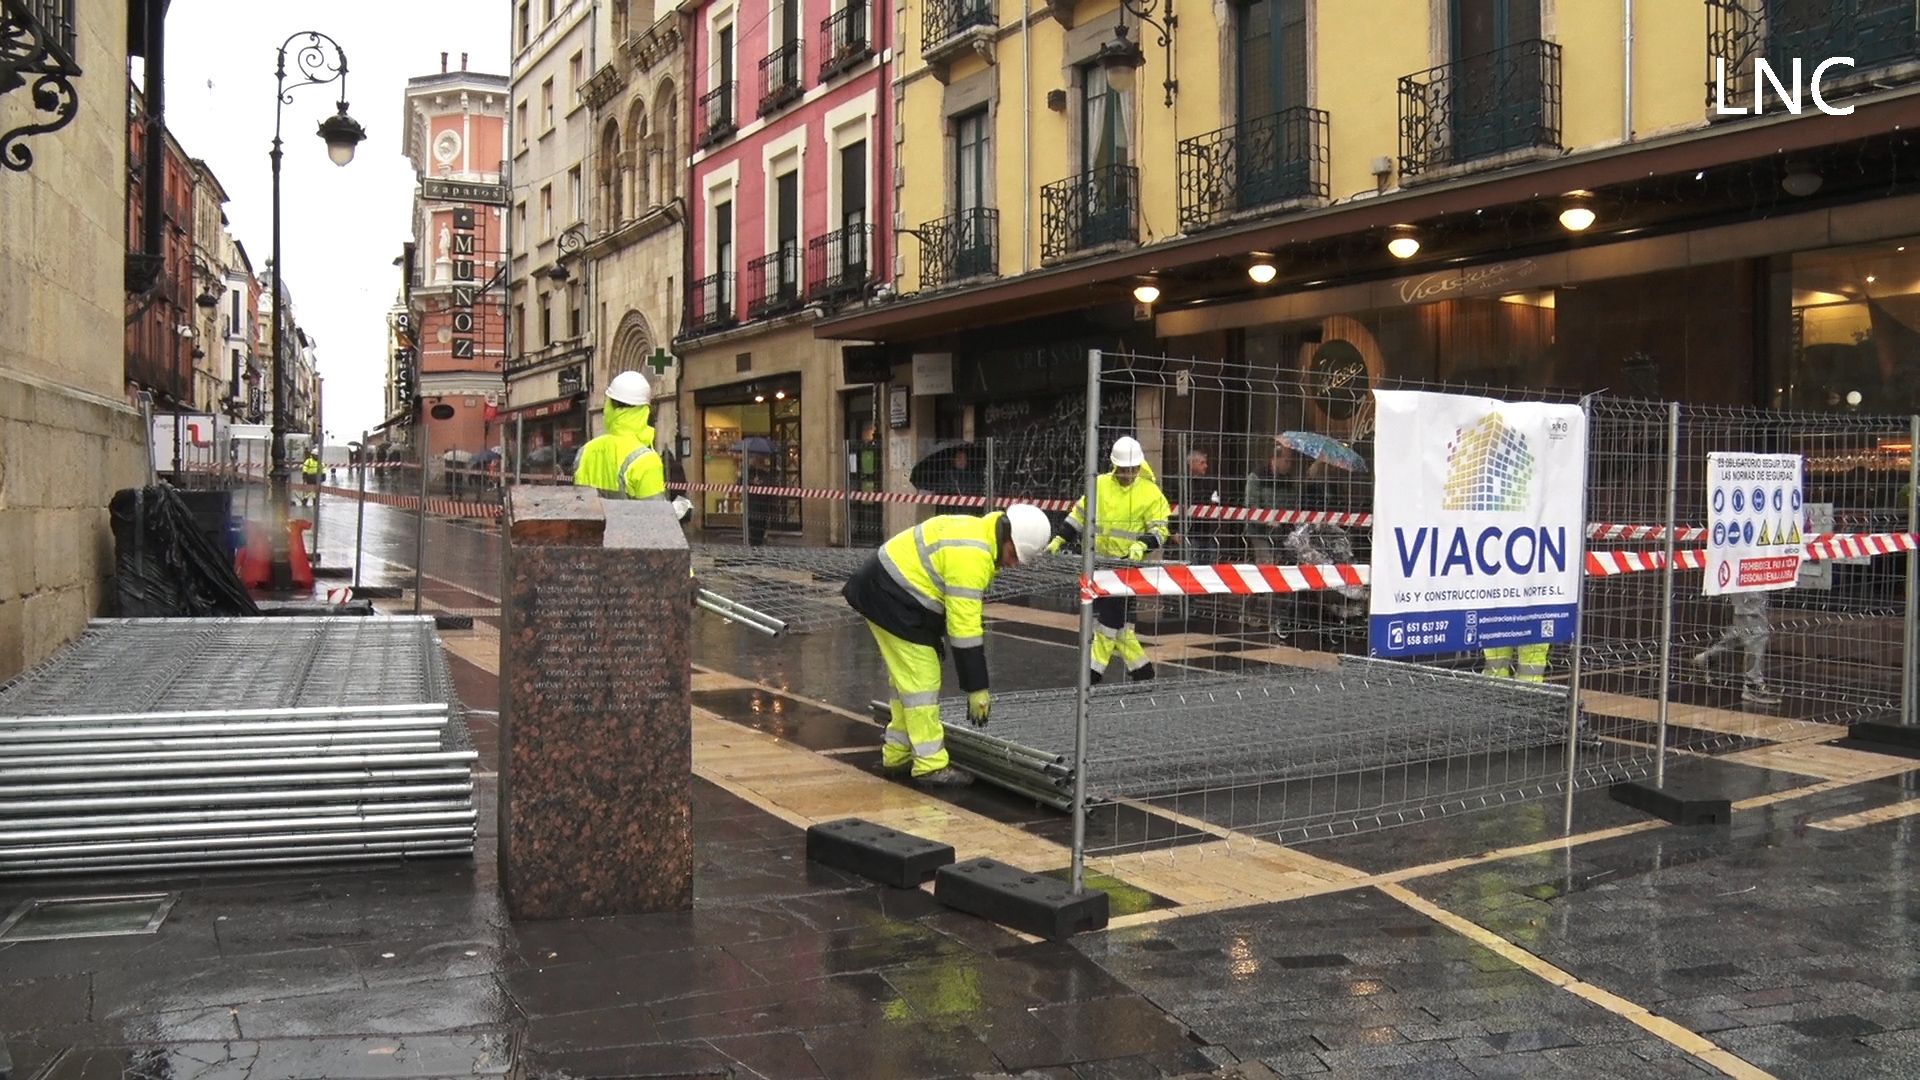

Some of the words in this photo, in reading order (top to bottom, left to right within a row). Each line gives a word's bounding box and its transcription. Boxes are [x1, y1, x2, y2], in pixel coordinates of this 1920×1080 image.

[431, 184, 499, 198] zapatos
[1721, 471, 1731, 481] LAS
[1757, 471, 1765, 481] DE
[1394, 527, 1566, 578] VIACON
[1414, 592, 1421, 602] Y
[1424, 588, 1501, 602] CONSTRUCCIONES
[1503, 587, 1521, 598] DEL
[1523, 586, 1547, 597] NORTE
[1548, 586, 1565, 596] S.L.
